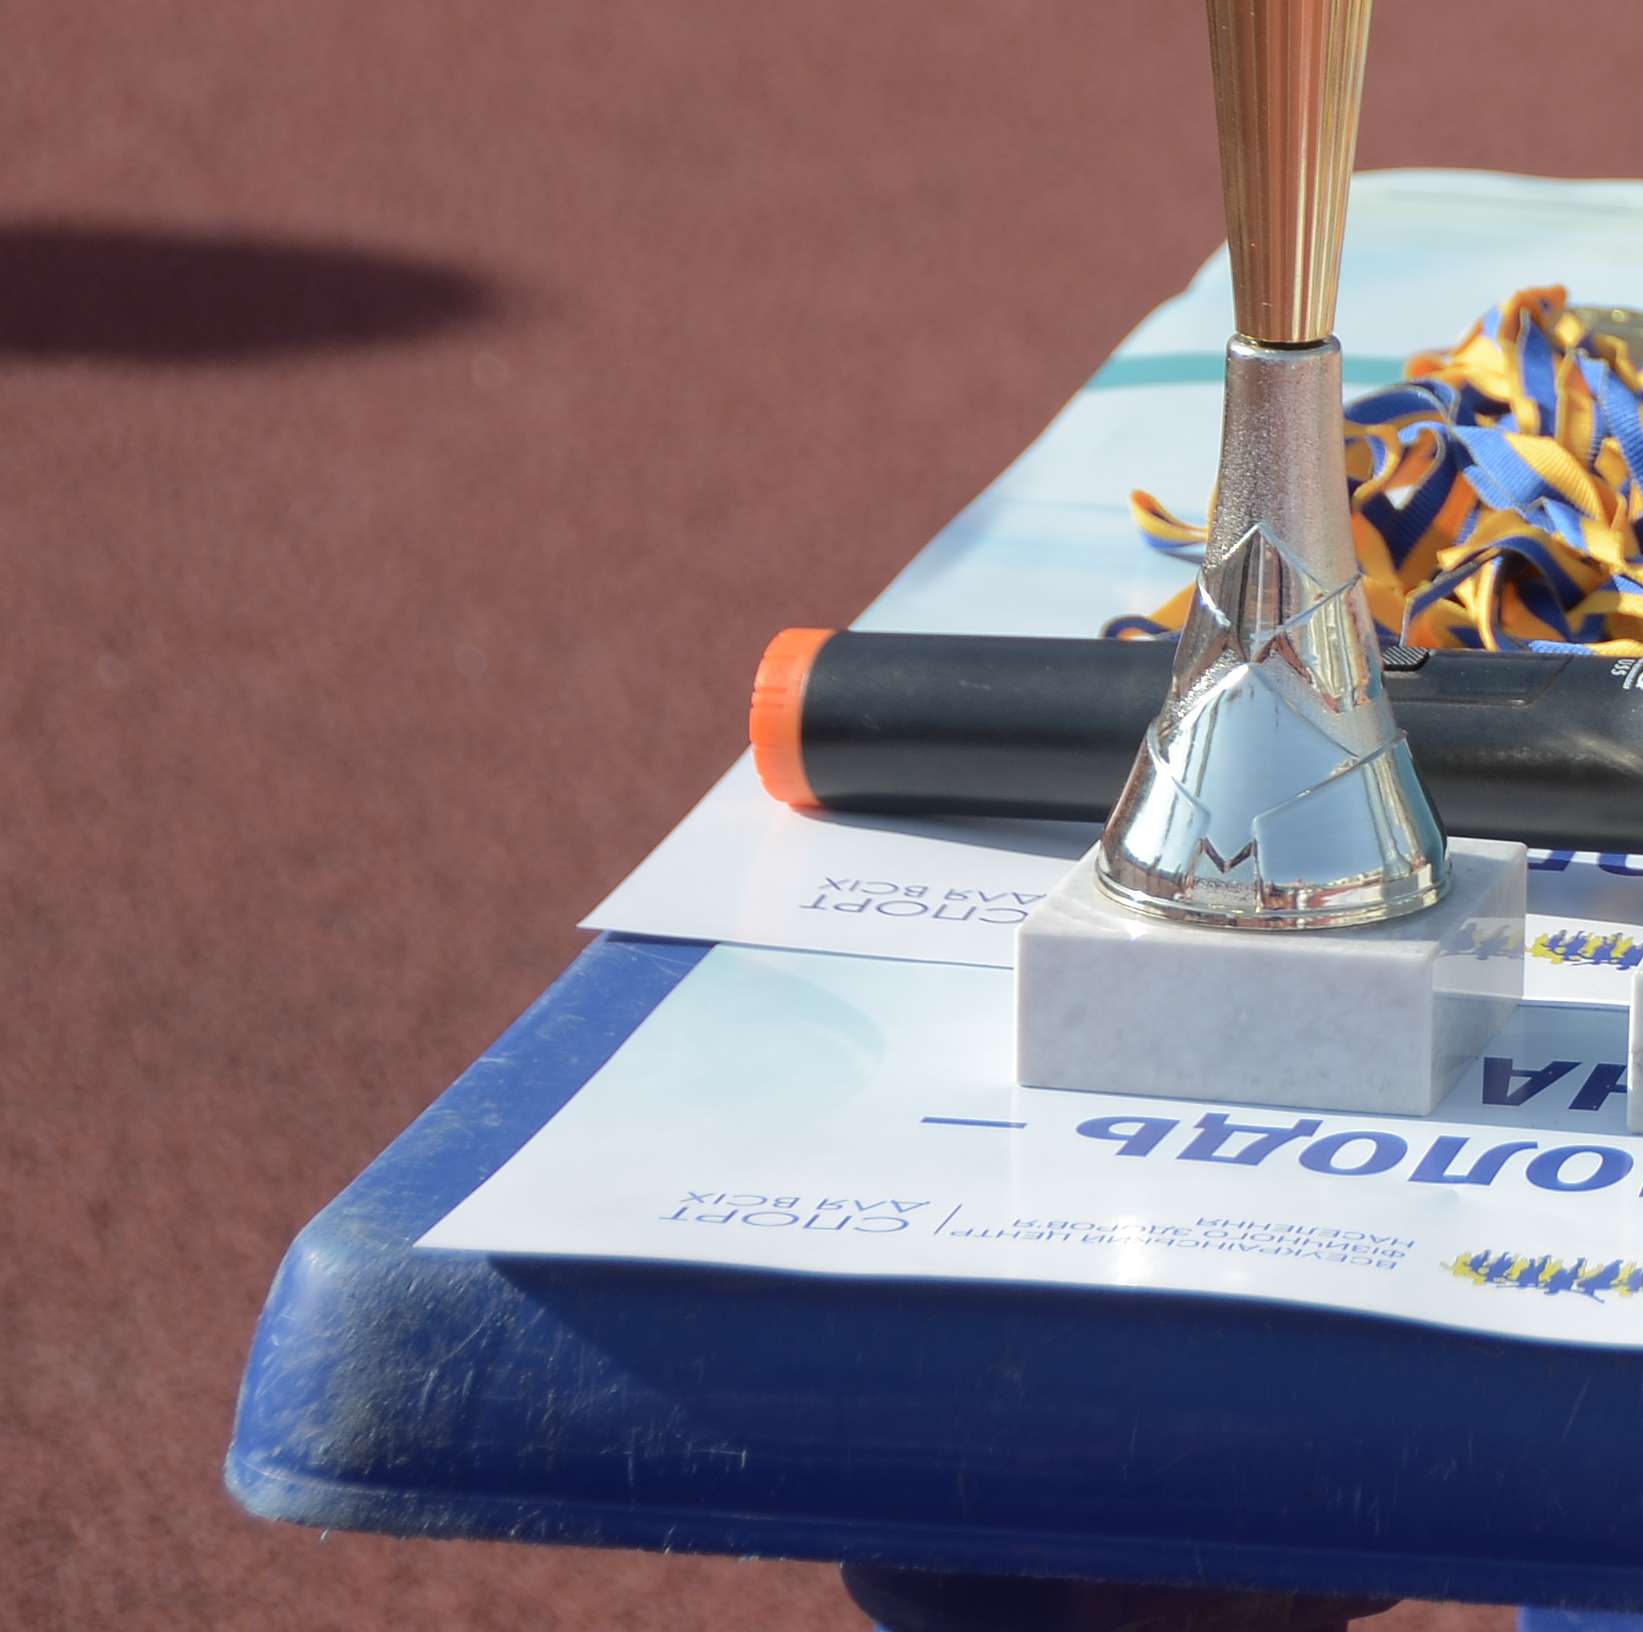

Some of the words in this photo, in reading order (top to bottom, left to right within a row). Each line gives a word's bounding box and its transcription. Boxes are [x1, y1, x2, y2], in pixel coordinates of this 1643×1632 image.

[816, 877, 929, 897] ВСІХ
[944, 888, 1048, 906] ДЛЯ
[798, 894, 1029, 925] СПОРТ
[678, 1191, 801, 1210] ВСІХ
[815, 1198, 931, 1214] ДЛЯ
[657, 1205, 910, 1234] СПОРТ
[1010, 1218, 1193, 1237] ЗДОРОВ'Я
[948, 1227, 1071, 1242] ЦЕНТР
[1194, 1217, 1416, 1250] НАСЕЛЕННЯ
[1080, 1232, 1398, 1271] ВСЕУКРАЇНСЬКИЙ
[1202, 1230, 1407, 1259] ФІЗИЧНОГО
